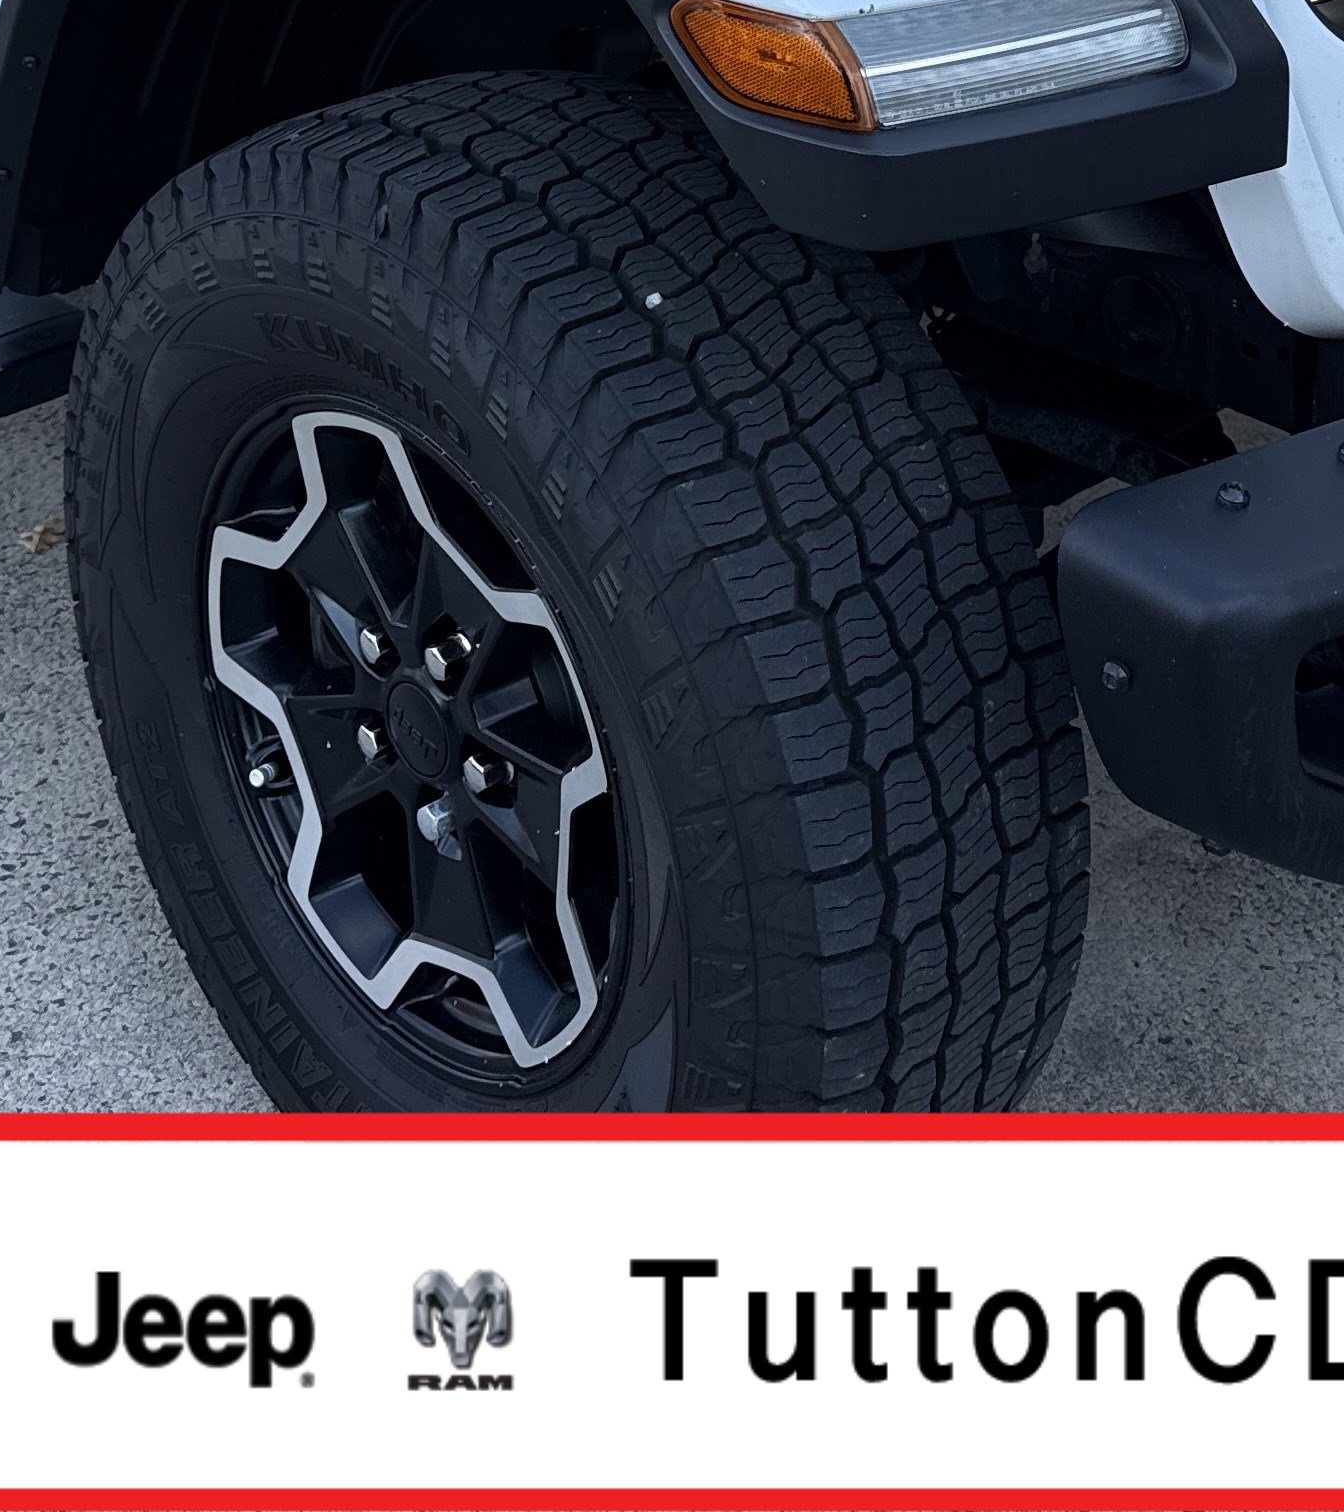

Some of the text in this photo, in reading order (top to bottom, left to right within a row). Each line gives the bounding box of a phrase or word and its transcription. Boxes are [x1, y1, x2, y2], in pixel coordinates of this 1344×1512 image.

[255, 313, 471, 457] KUMHO
[134, 719, 374, 1112] TAINEER AT2
